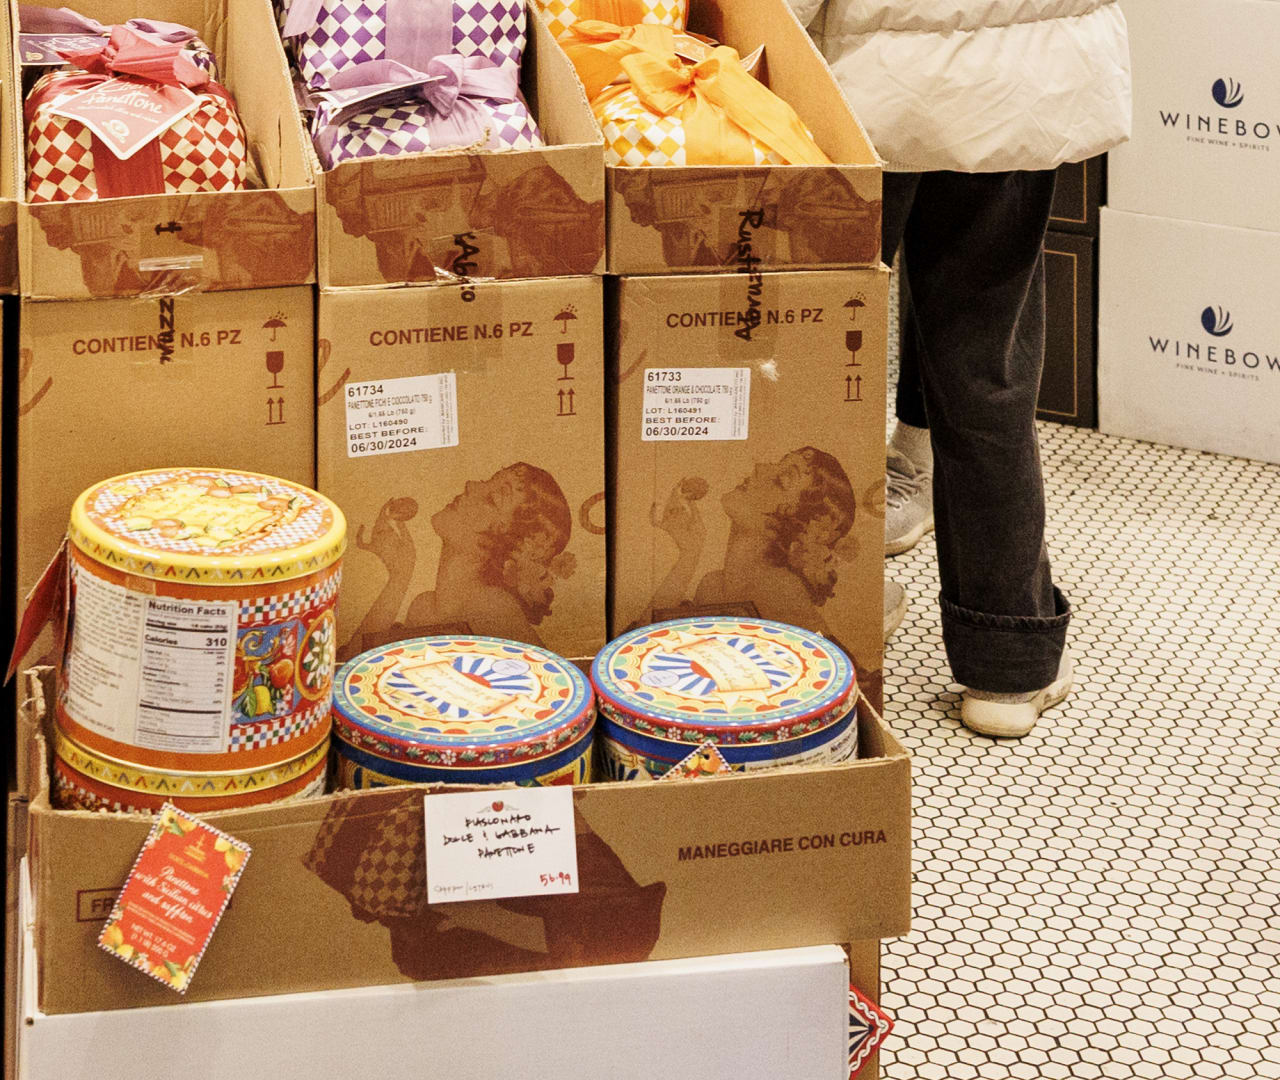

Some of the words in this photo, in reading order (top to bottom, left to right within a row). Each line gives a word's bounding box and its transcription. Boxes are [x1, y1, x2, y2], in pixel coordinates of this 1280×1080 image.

[1186, 136, 1205, 144] FINE
[1208, 138, 1229, 147] WINE
[1239, 141, 1270, 152] SPIRITS
[767, 309, 795, 325] N.6
[800, 308, 824, 323] PZ
[181, 332, 211, 348] N.6
[217, 329, 242, 345] PZ
[369, 325, 469, 347] CONTIENE
[474, 323, 504, 340] N.6
[509, 322, 534, 337] PZ
[647, 371, 682, 382] 61733
[1176, 363, 1194, 371] FINE
[1197, 365, 1218, 375] WINE
[1228, 370, 1260, 382] SPIRITS
[348, 384, 384, 397] 61734
[349, 422, 370, 431] LOT:
[675, 416, 720, 424] BEFORE:
[350, 431, 379, 441] BEST
[381, 426, 428, 437] BEFORE:
[645, 426, 709, 436] 06/30/2024
[351, 437, 418, 453] 06/30/2024
[148, 601, 194, 615] Nutrition
[197, 606, 227, 616] Facts
[144, 633, 178, 646] Calories
[206, 637, 228, 647] 310
[678, 837, 794, 861] MANEGGIARE
[798, 833, 835, 850] CON
[839, 829, 887, 847] CURA
